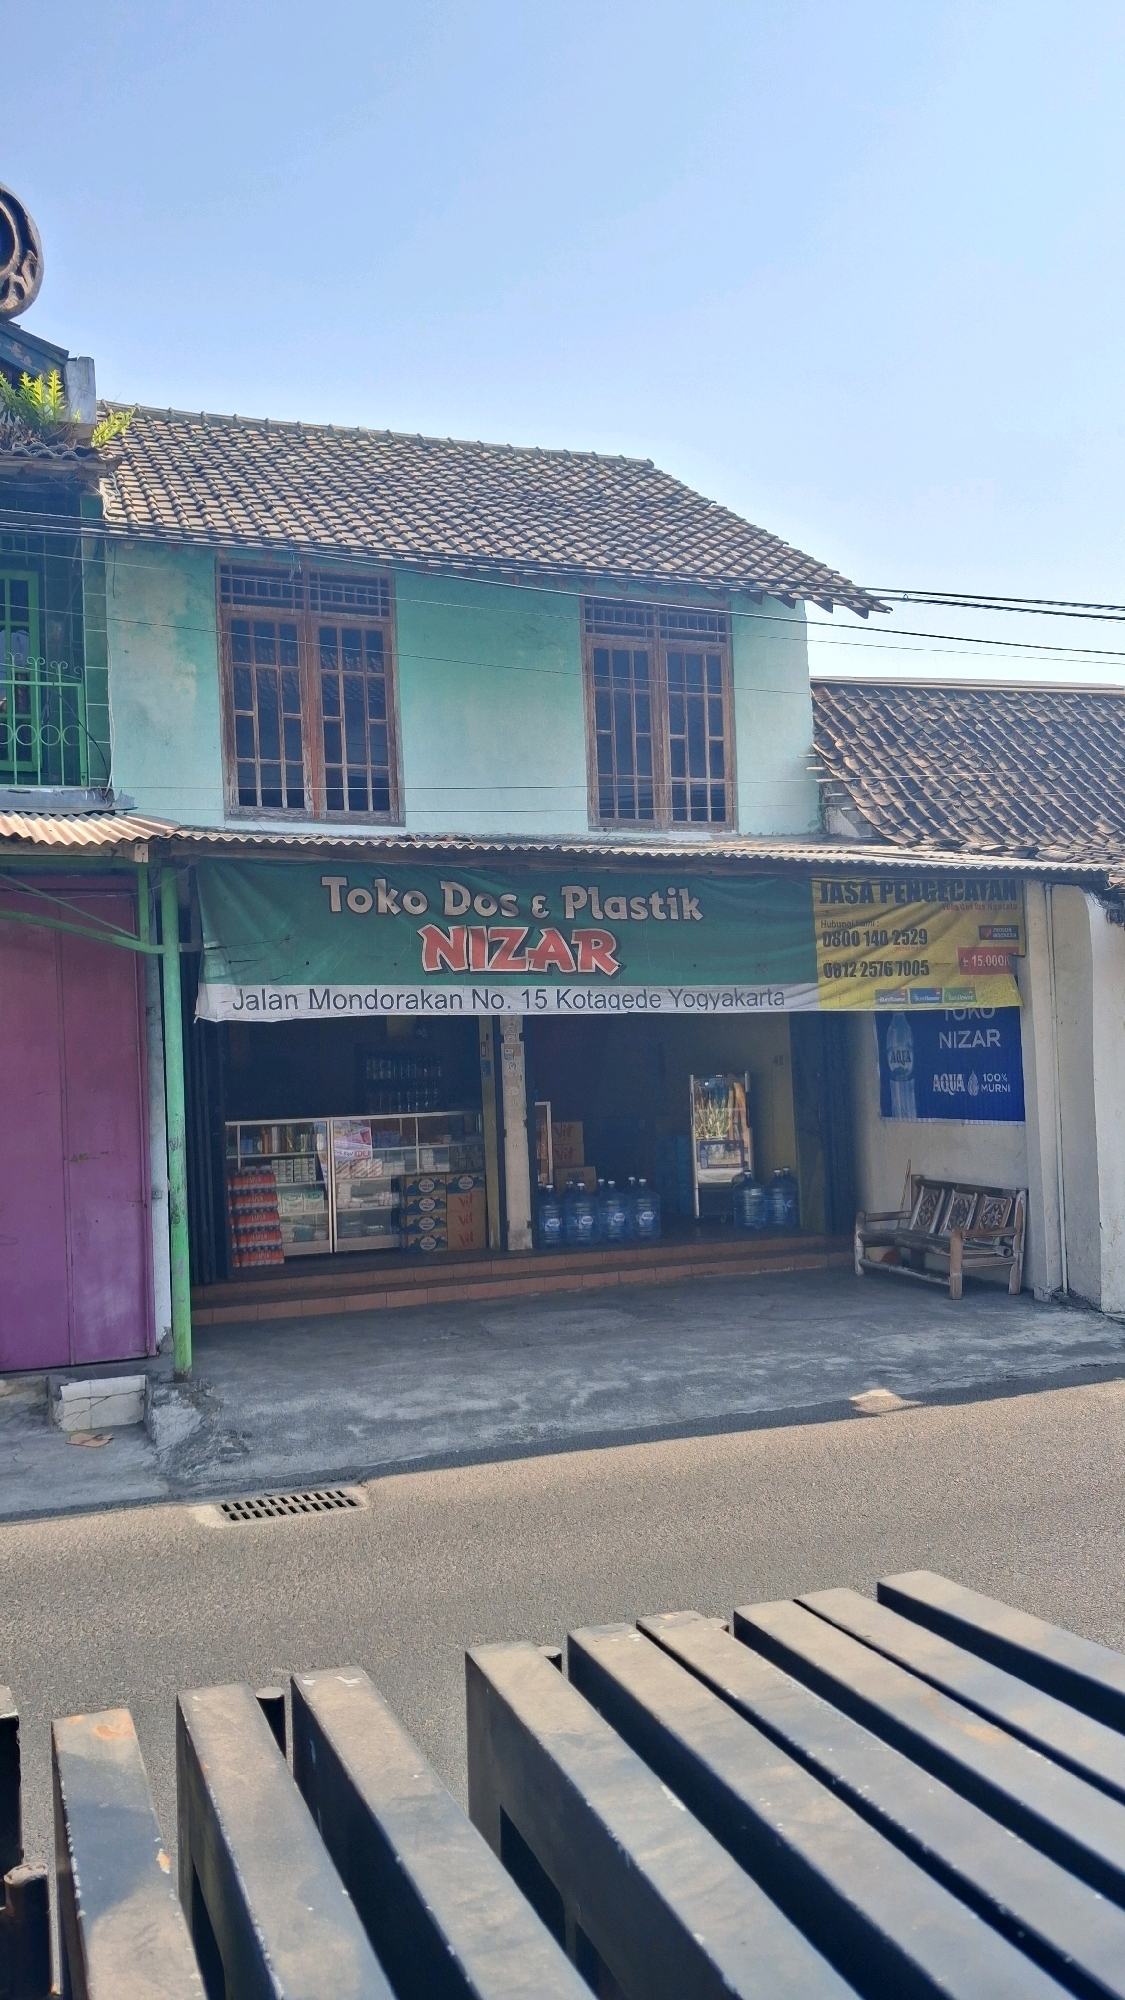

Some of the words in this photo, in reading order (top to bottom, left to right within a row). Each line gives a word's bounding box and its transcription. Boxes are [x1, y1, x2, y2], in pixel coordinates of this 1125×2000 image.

[320, 875, 428, 915] Toko
[439, 879, 520, 918] Dos
[561, 885, 704, 921] Plastik
[820, 880, 874, 904] JASA
[880, 879, 1017, 904] PENGECATAN
[822, 930, 860, 948] 0800
[864, 930, 889, 947] 140
[892, 928, 928, 946] 2529
[416, 923, 621, 976] NIZAR
[823, 962, 857, 979] 0812
[860, 960, 894, 978] 2576
[232, 988, 298, 1012] Jalan
[309, 988, 463, 1010] Mondorakan
[472, 988, 510, 1010] No.
[521, 988, 548, 1010] 15
[556, 987, 662, 1011] Kotagede
[668, 987, 785, 1011] Yogyakarta
[938, 1029, 1001, 1049] NIZAR
[890, 1050, 911, 1064] AQUA
[932, 1073, 966, 1095] AQUA
[980, 1082, 1011, 1093] MURNI
[982, 1072, 1008, 1083] 100%
